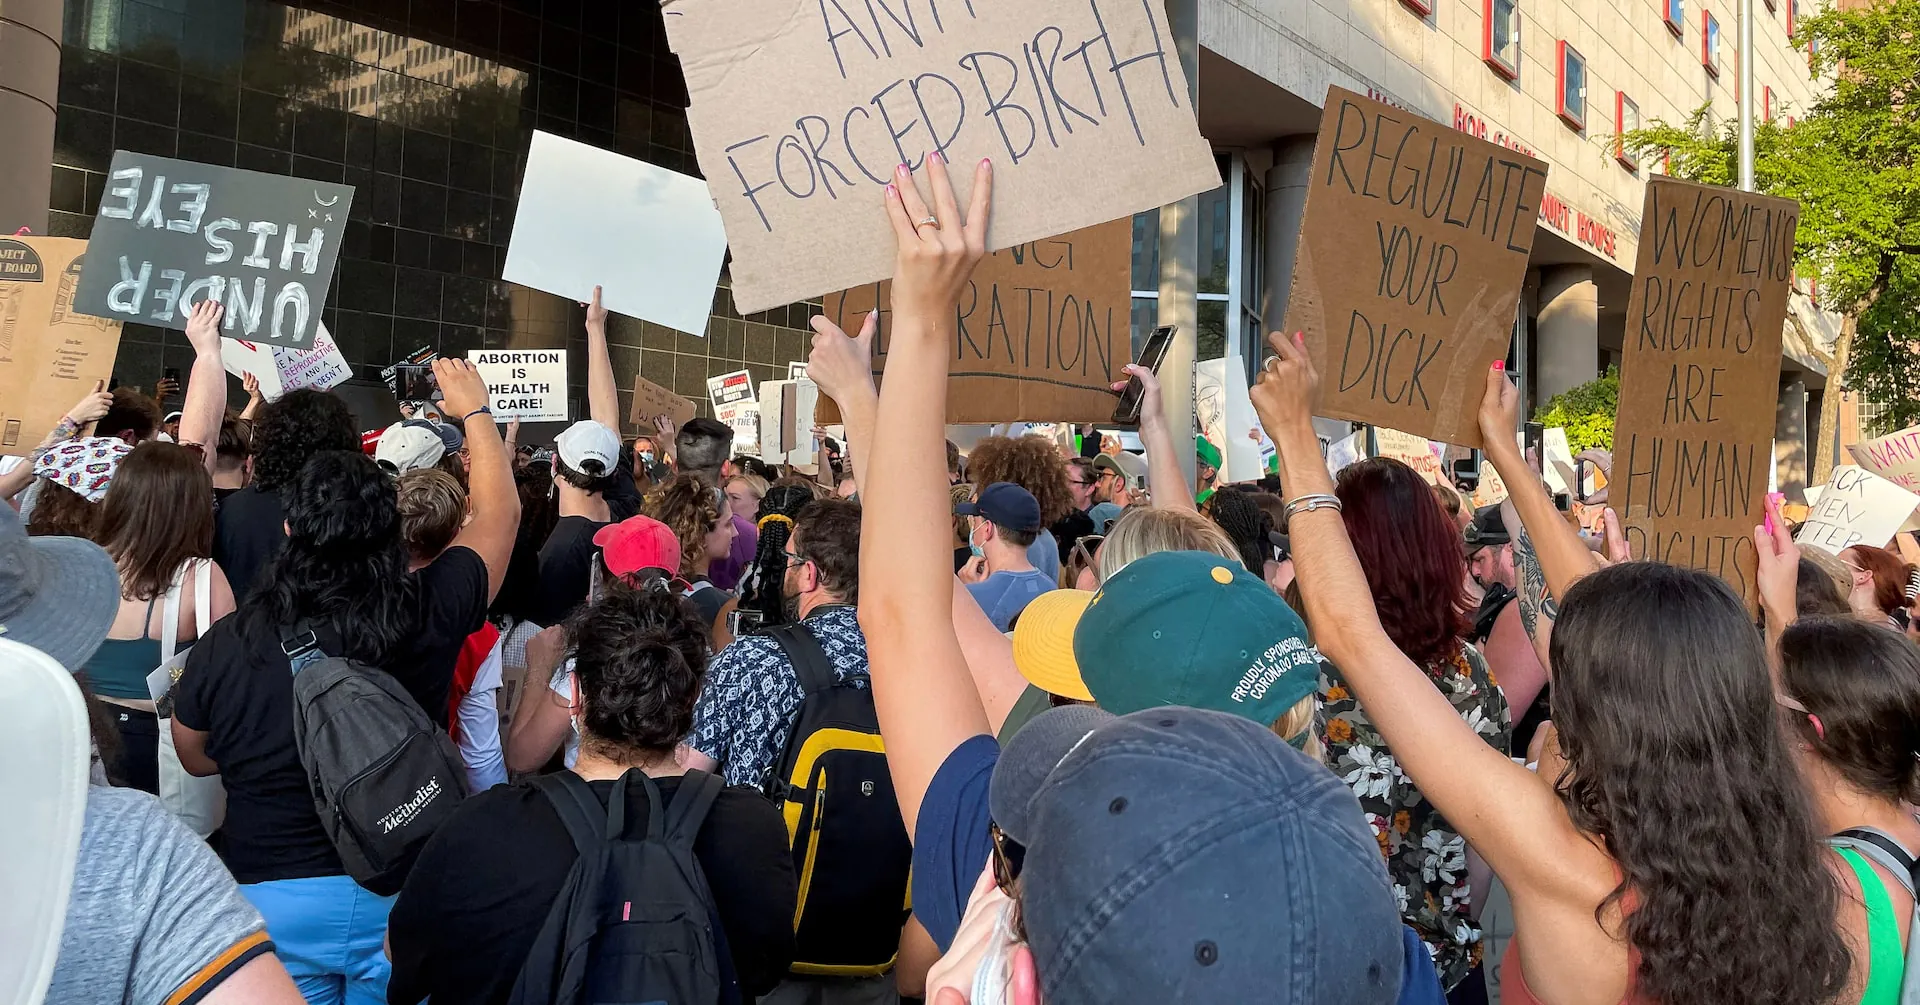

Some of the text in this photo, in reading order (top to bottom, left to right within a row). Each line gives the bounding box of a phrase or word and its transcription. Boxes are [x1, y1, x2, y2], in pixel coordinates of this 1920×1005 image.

[726, 0, 1179, 232] FORCED BIRTH
[1327, 99, 1546, 254] REGULATE
[101, 165, 325, 275] HIS EYE
[1577, 212, 1616, 259] HOUSE
[1651, 186, 1797, 282] WOMEN'S
[5, 262, 38, 274] BOARD
[1376, 220, 1459, 317] YOUR
[107, 255, 310, 342] UNDER
[1639, 276, 1760, 354] RIGHTS
[283, 342, 337, 378] REPRODUCTIVE
[304, 365, 321, 380] AND
[478, 353, 560, 364] ABORTION
[512, 368, 527, 379] IS
[1340, 309, 1443, 411] DICK
[488, 383, 550, 395] HEALTH
[497, 398, 543, 410] CARE!
[711, 380, 725, 391] STOP
[1663, 363, 1726, 424] ARE
[737, 418, 752, 426] THE
[1625, 433, 1754, 520] HUMAN
[1231, 657, 1267, 703] PROUDLY
[1250, 656, 1292, 700] CORONADO
[376, 805, 403, 826] HOUSTON
[383, 778, 440, 834] Methodist
